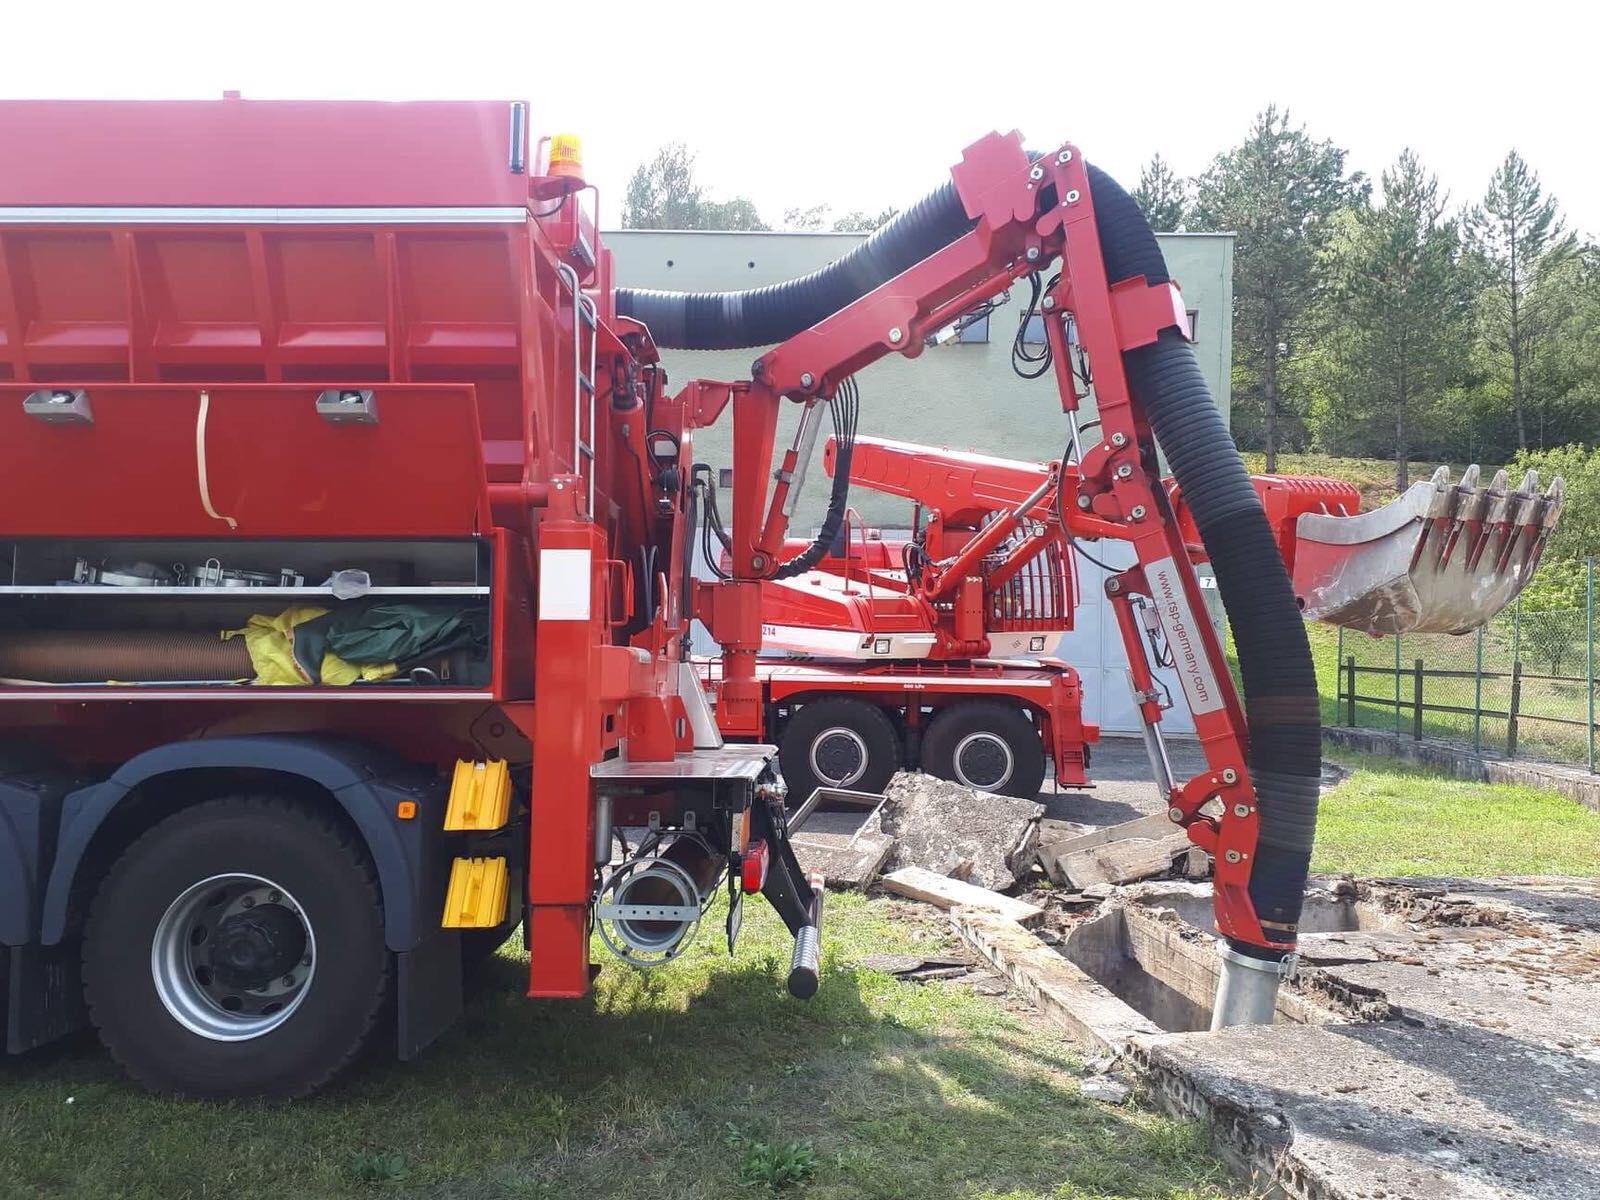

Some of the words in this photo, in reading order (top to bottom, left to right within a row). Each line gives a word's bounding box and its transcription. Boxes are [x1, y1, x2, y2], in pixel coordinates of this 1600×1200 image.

[1205, 578, 1211, 587] 7
[762, 626, 776, 637] 214
[1157, 570, 1209, 703] www.rsp-germany.com
